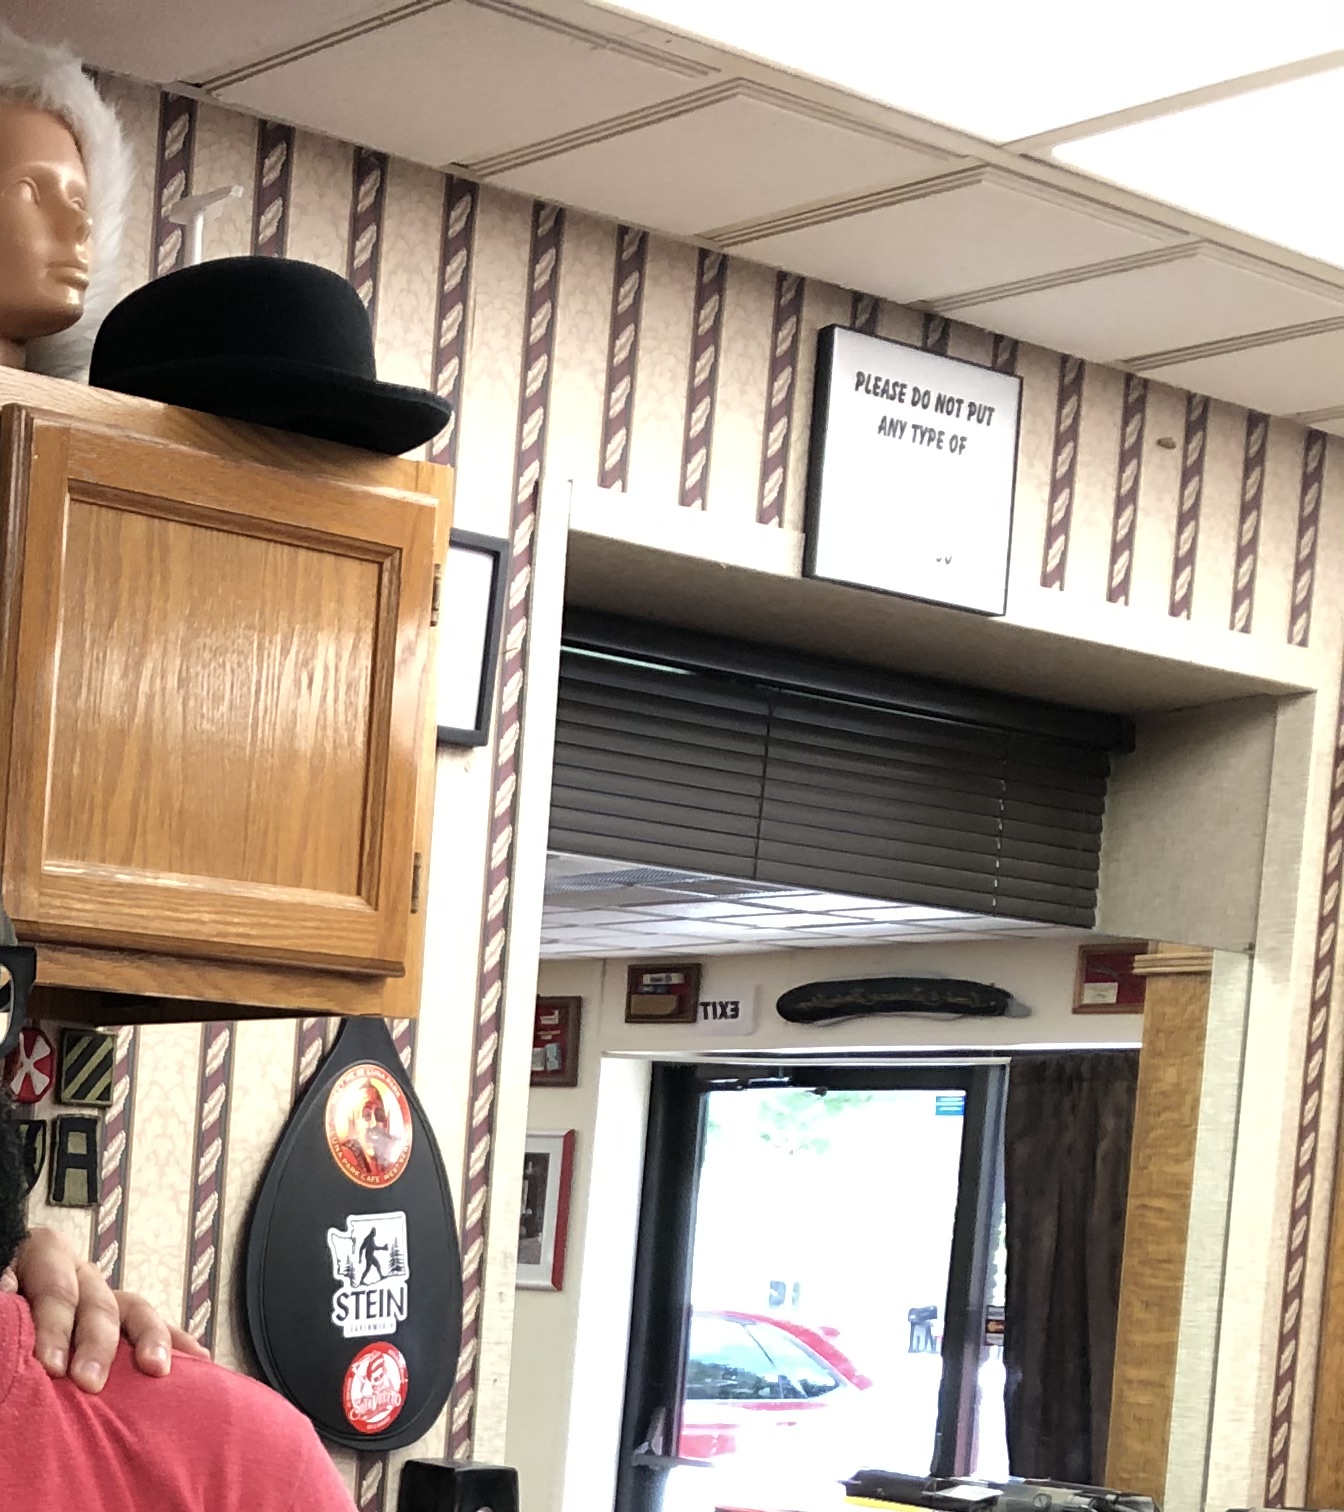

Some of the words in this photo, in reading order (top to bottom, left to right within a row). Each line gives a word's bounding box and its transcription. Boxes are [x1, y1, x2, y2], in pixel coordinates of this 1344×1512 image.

[854, 371, 908, 403] PLEASE
[911, 386, 931, 410] DO
[934, 393, 964, 418] NOT
[967, 401, 996, 427] PUT
[878, 415, 907, 440] ANY
[911, 424, 945, 450] TYPE
[949, 434, 968, 455] OF
[336, 1286, 404, 1322] STEIN
